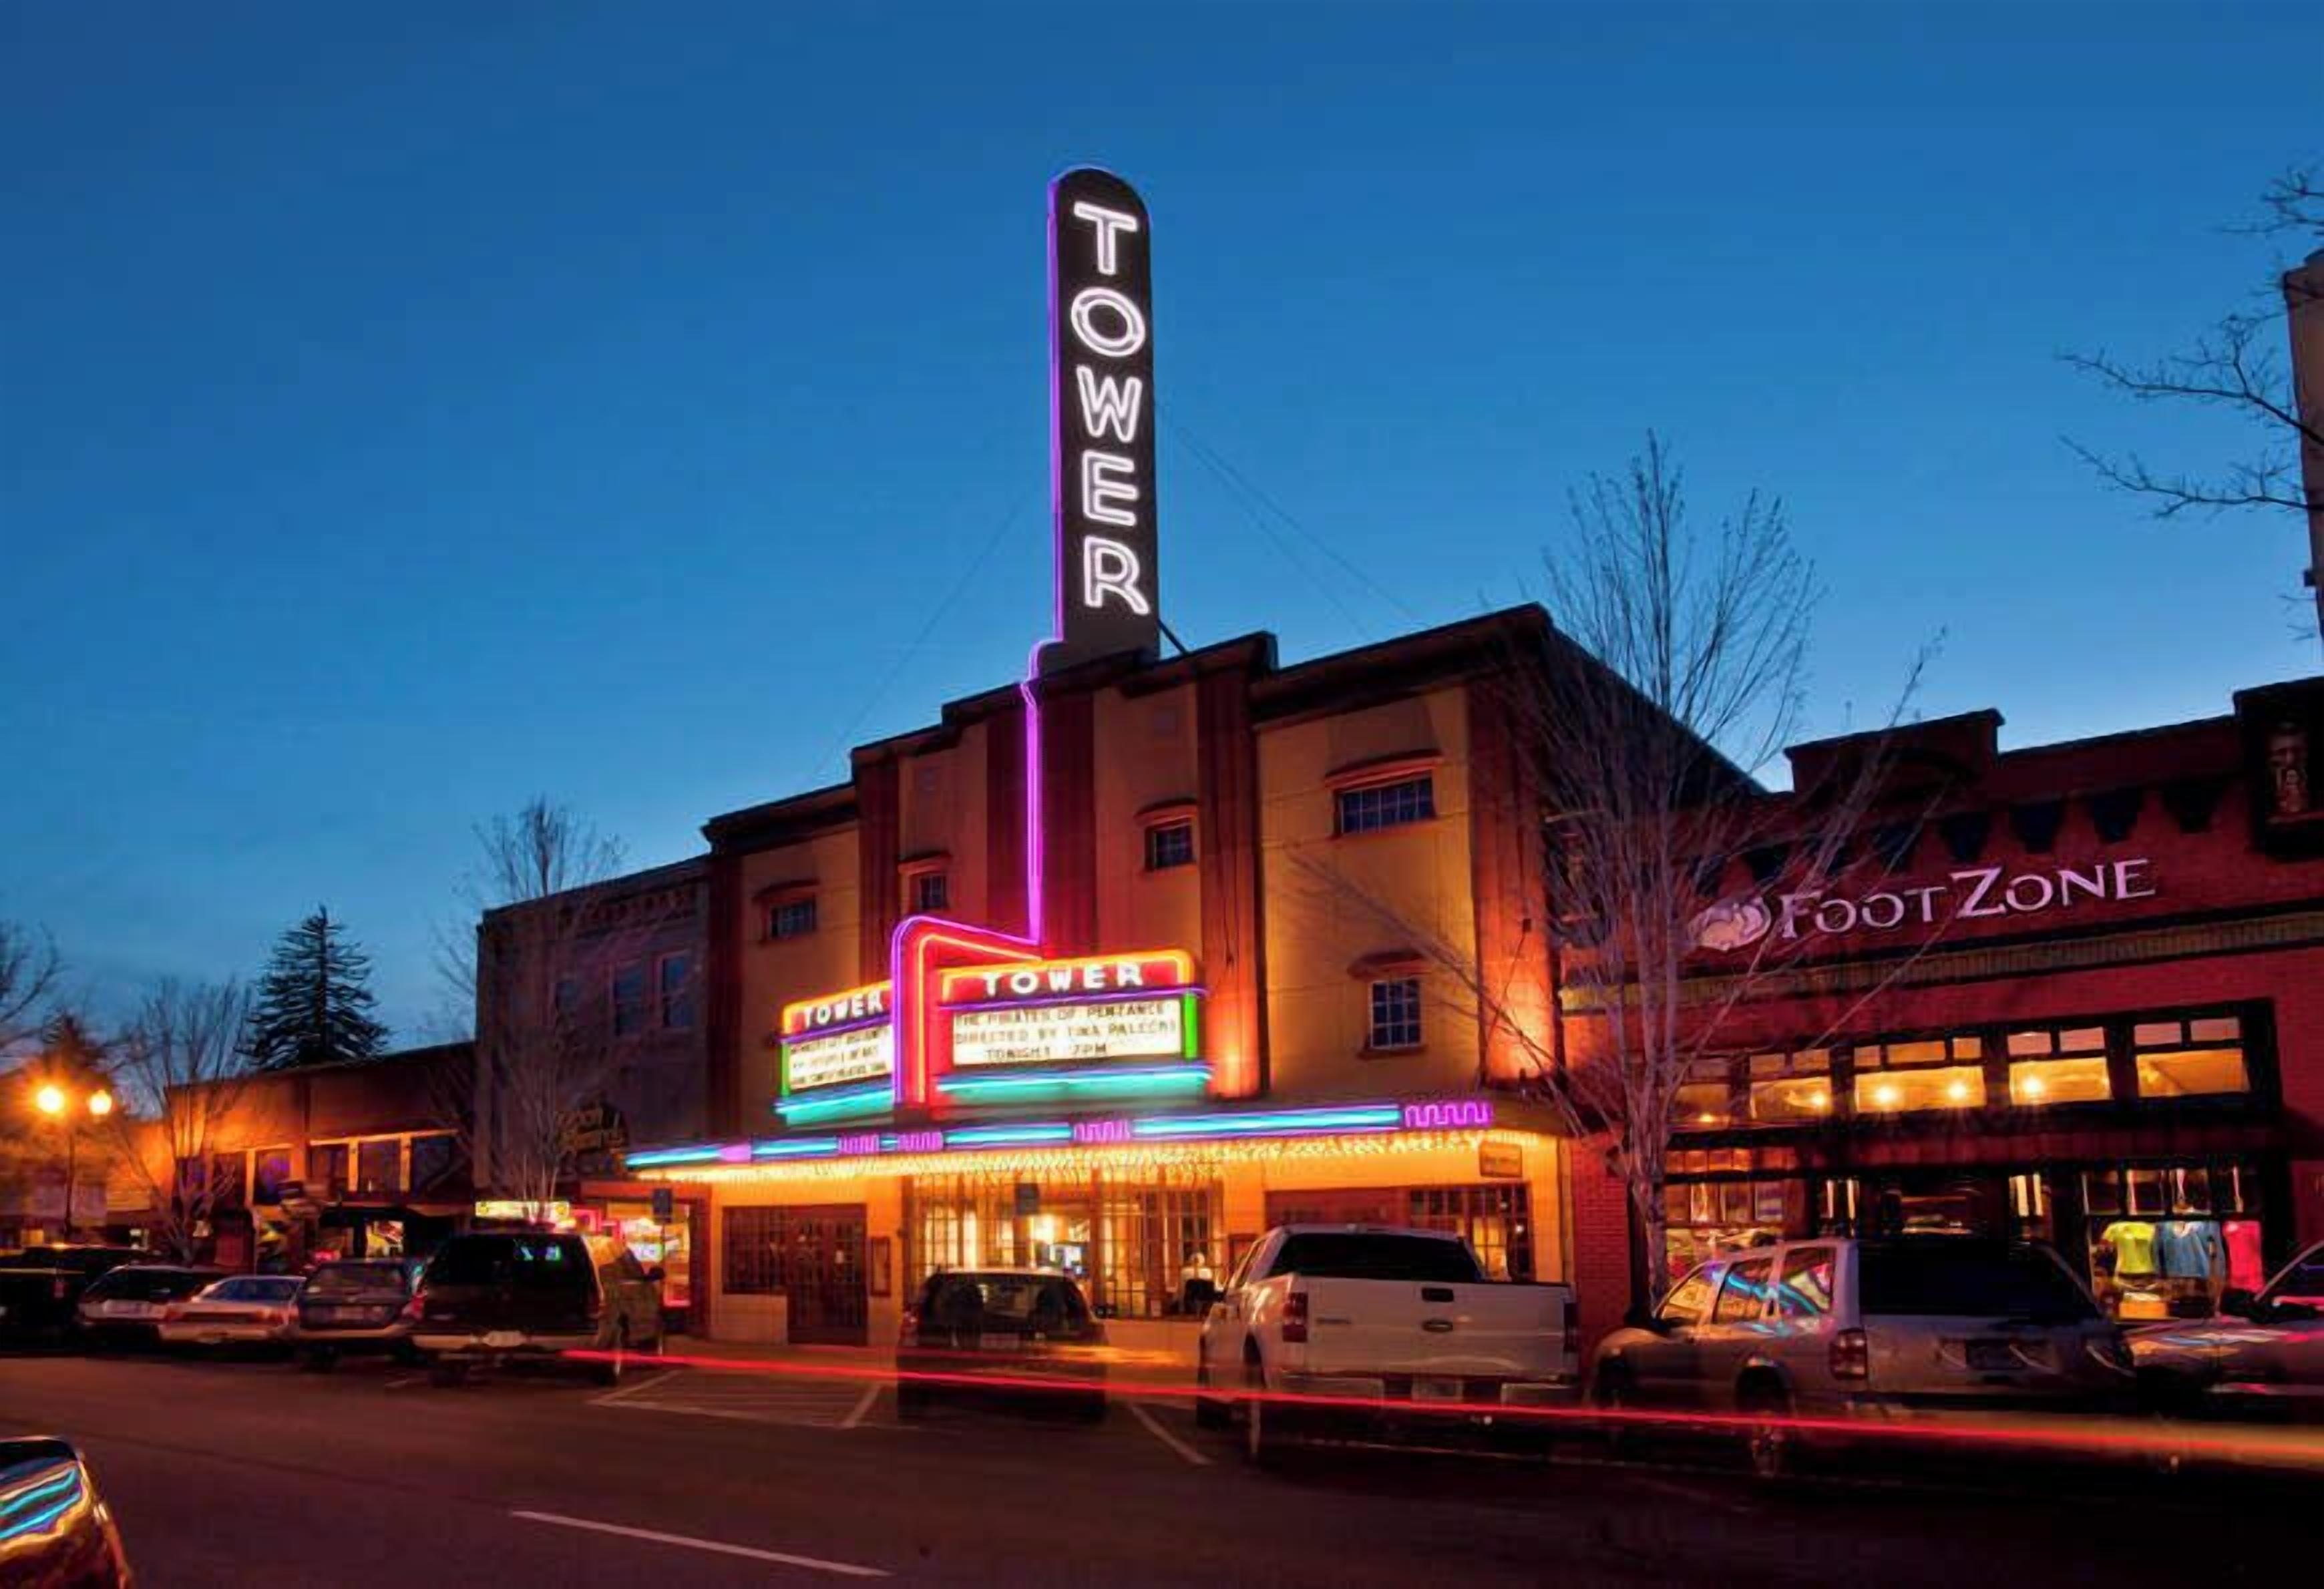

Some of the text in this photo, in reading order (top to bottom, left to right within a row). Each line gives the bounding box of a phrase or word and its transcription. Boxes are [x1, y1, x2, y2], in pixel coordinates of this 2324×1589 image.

[1070, 200, 1149, 615] TOWER
[983, 961, 1144, 997] TOWER
[803, 989, 884, 1030] TOWER
